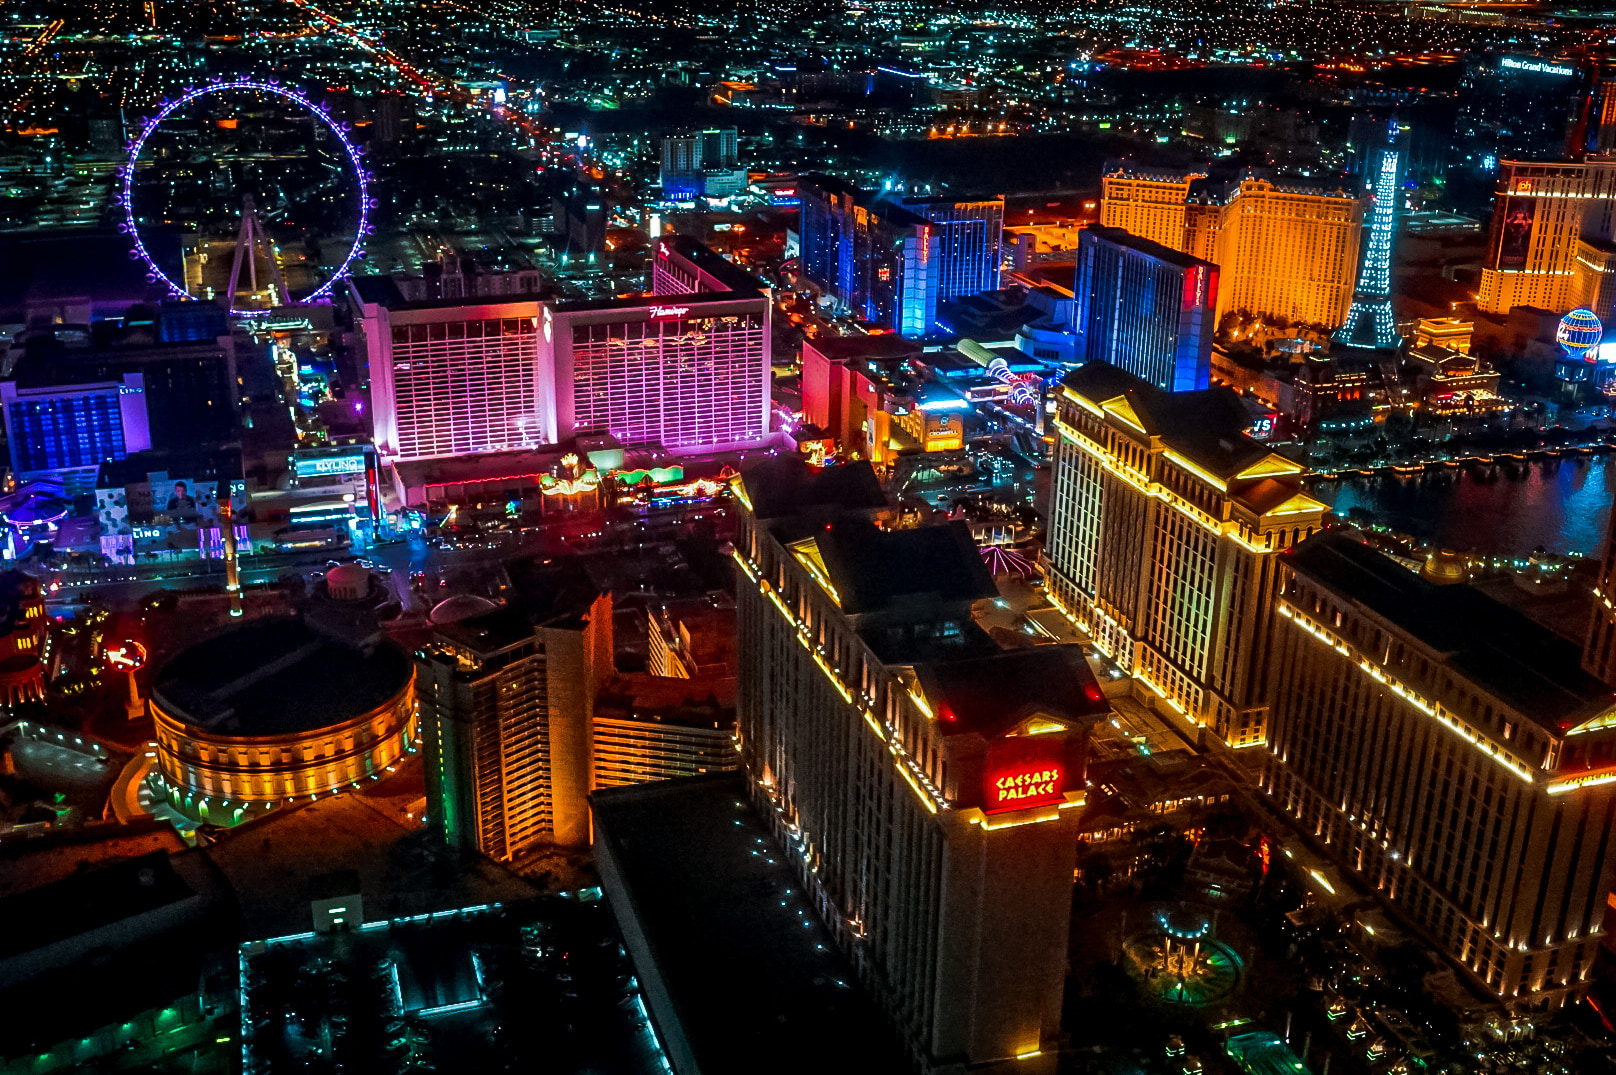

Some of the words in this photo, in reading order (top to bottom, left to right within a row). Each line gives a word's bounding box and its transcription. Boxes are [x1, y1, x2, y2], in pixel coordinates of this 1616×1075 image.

[1501, 58, 1521, 69] Hilton
[1521, 61, 1542, 72] Grand
[1541, 63, 1573, 76] Vacations
[649, 306, 690, 318] Flamingo
[132, 529, 160, 539] LINQ
[995, 769, 1059, 789] CAESARS
[998, 782, 1054, 802] PALACE
